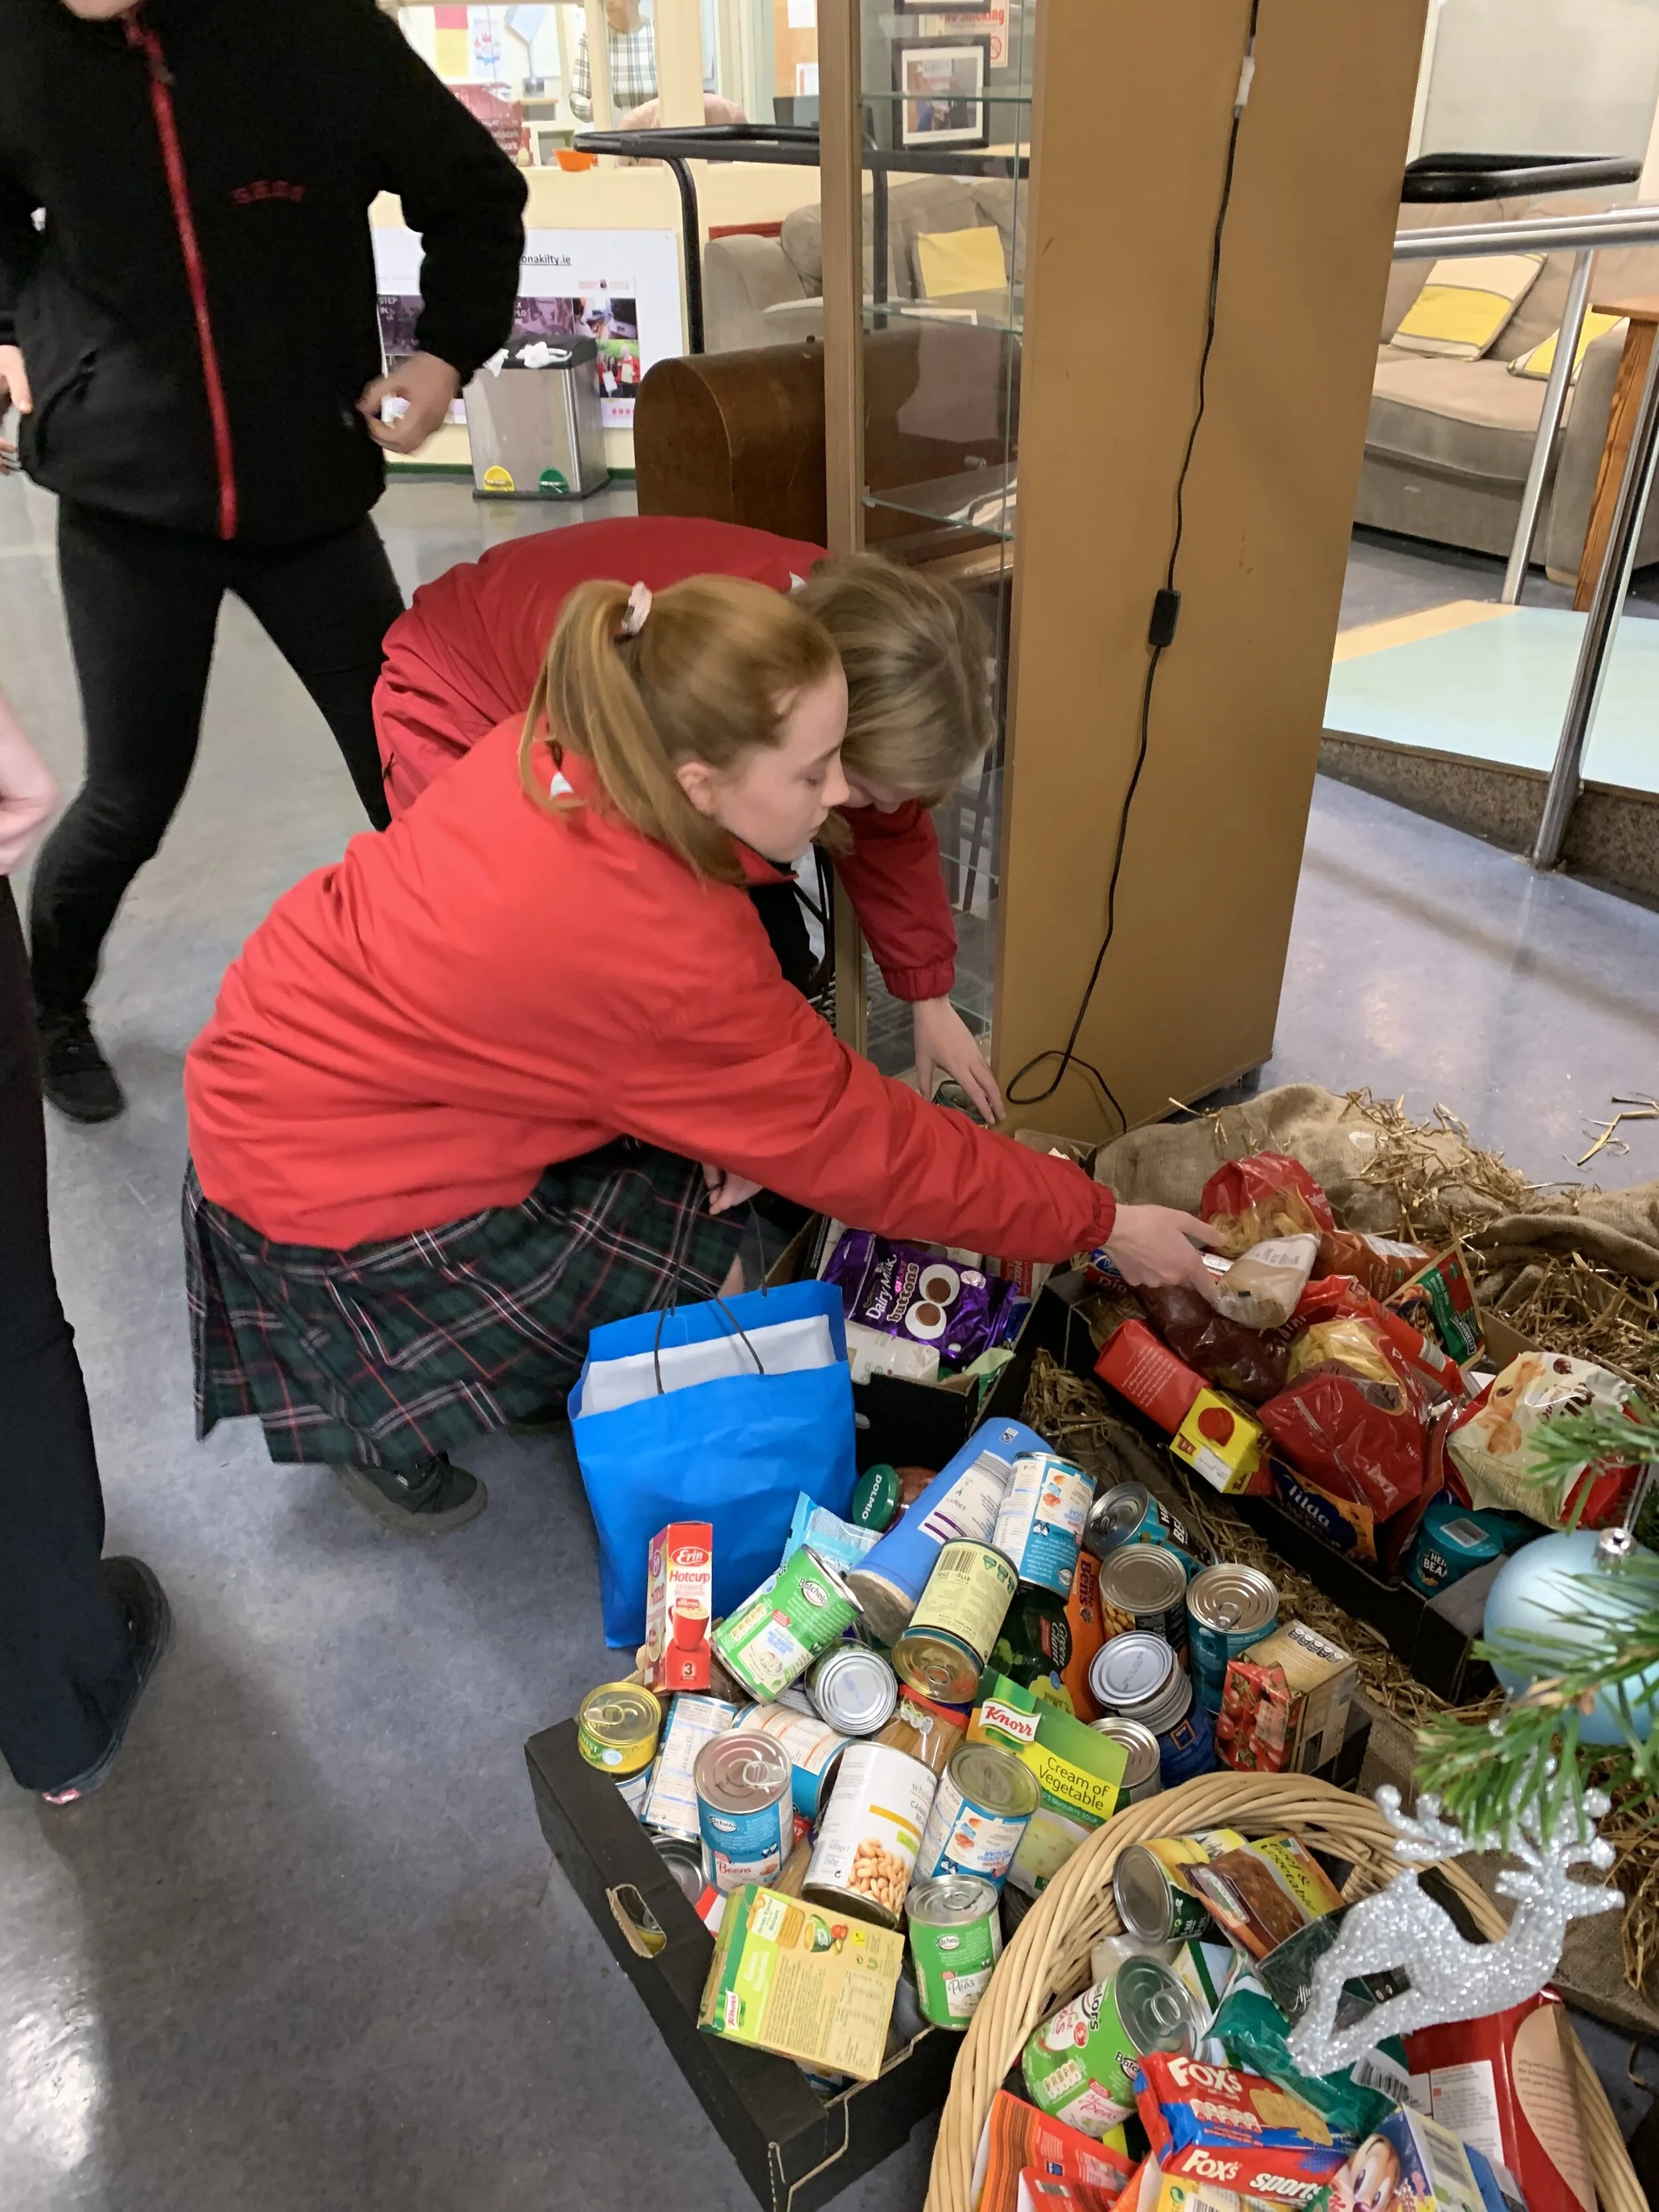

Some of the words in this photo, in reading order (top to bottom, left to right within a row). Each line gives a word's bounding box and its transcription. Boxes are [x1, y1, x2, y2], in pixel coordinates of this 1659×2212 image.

[865, 1286, 893, 1320] Dairy
[886, 1262, 920, 1323] buttons
[862, 1474, 883, 1520] DOLMIO
[1283, 1474, 1330, 1528] Tilda
[677, 1548, 703, 1565] Erin
[670, 1570, 710, 1585] Hotcup
[798, 1578, 828, 1605] Batchelo
[684, 1662, 693, 1676] 3
[984, 1705, 1033, 1737] Knorr
[1039, 1764, 1104, 1811] Vegetable
[1047, 1757, 1090, 1792] Cream
[1092, 1785, 1110, 1797] of
[1050, 1796, 1081, 1816] FAVOURITE
[1080, 1810, 1098, 1824] SOUP
[718, 1861, 751, 1874] Beans
[948, 1979, 975, 1996] Peas
[727, 1994, 737, 2026] Knorr
